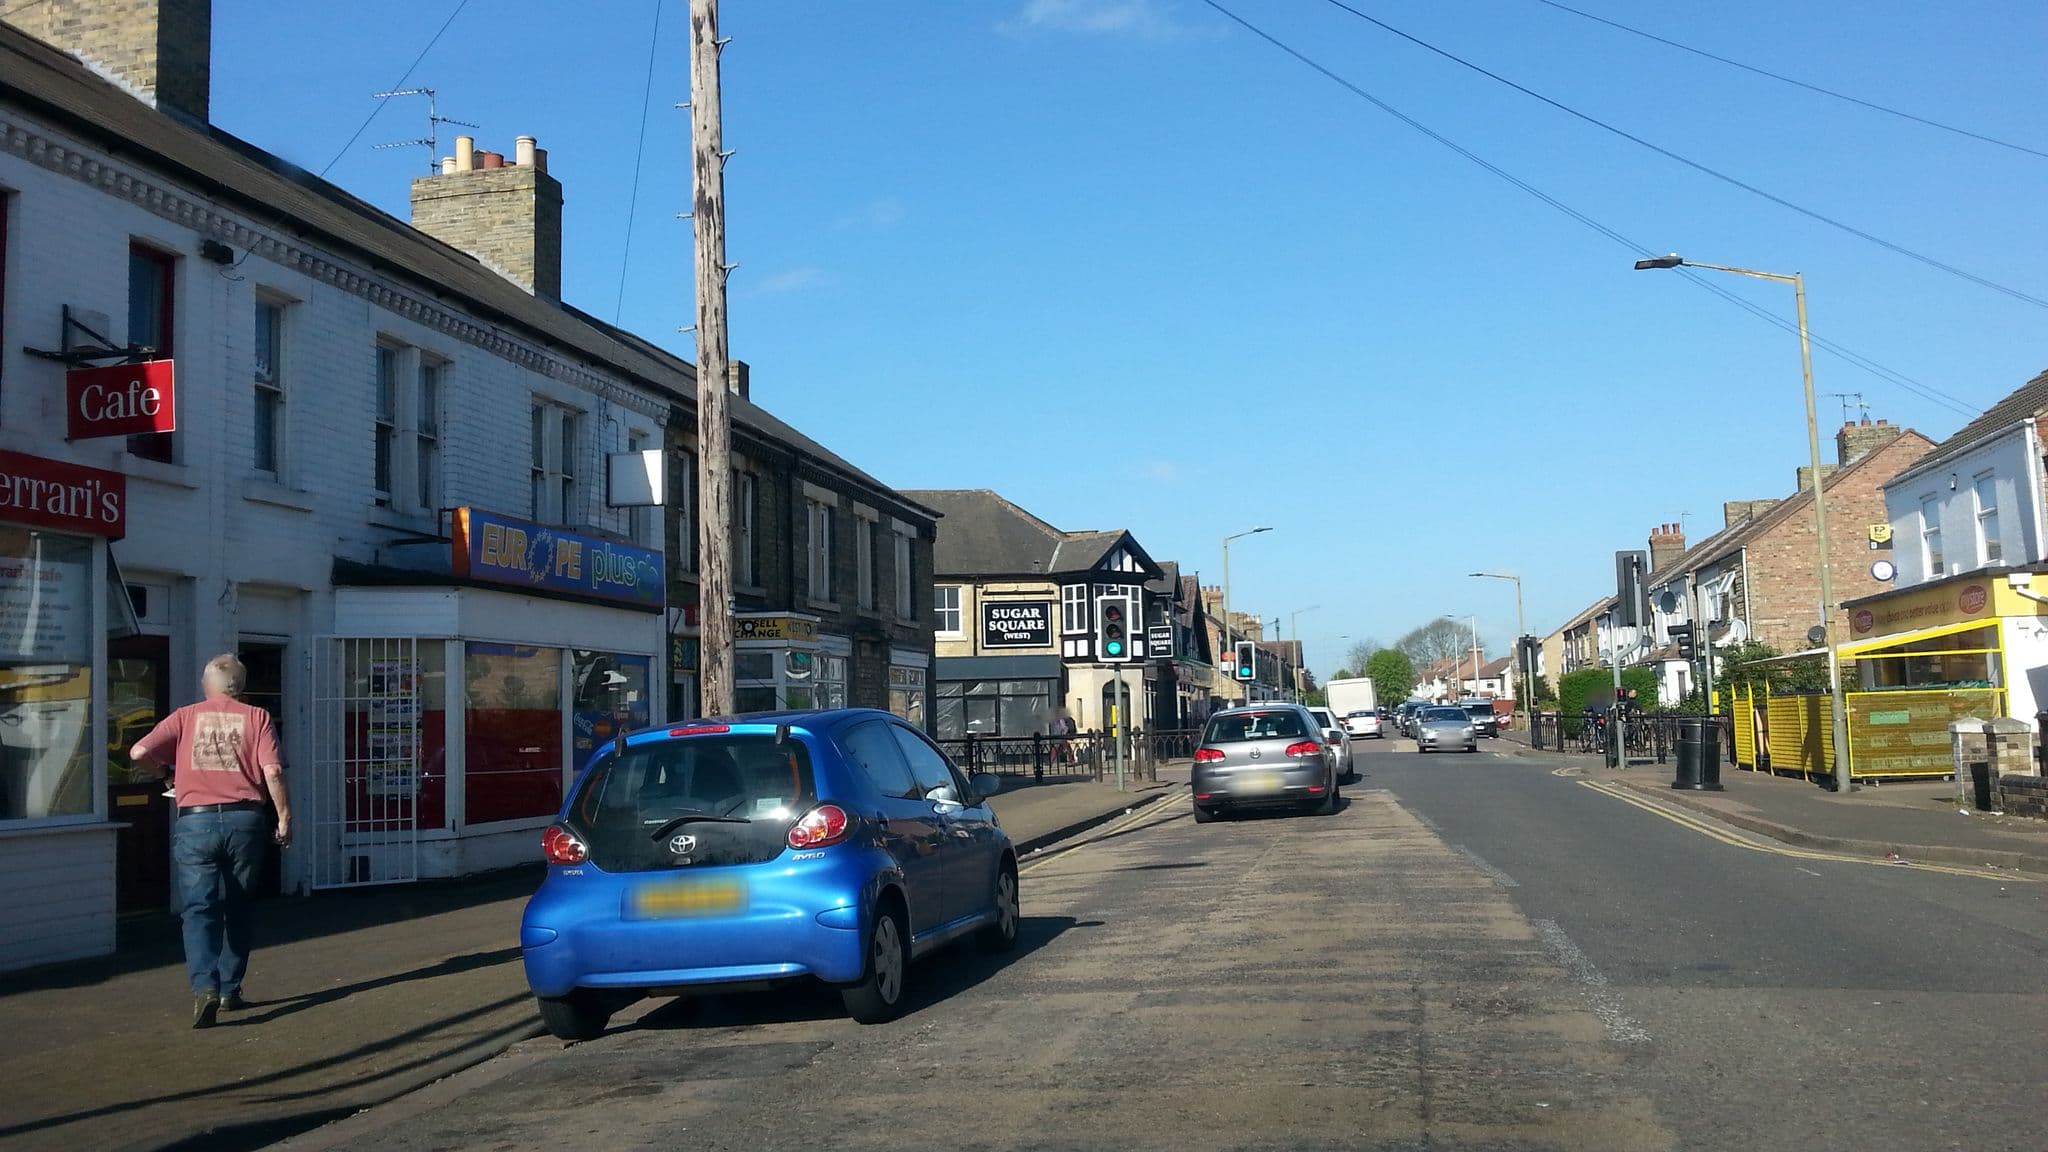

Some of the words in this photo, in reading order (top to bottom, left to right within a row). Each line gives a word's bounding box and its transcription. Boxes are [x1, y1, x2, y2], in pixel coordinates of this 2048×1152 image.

[80, 380, 160, 421] Cafe
[481, 522, 582, 583] EUROPE
[592, 543, 637, 589] plus
[992, 608, 1041, 619] SUGAR
[988, 620, 1045, 632] SQUARE
[1003, 632, 1031, 640] (WEST)
